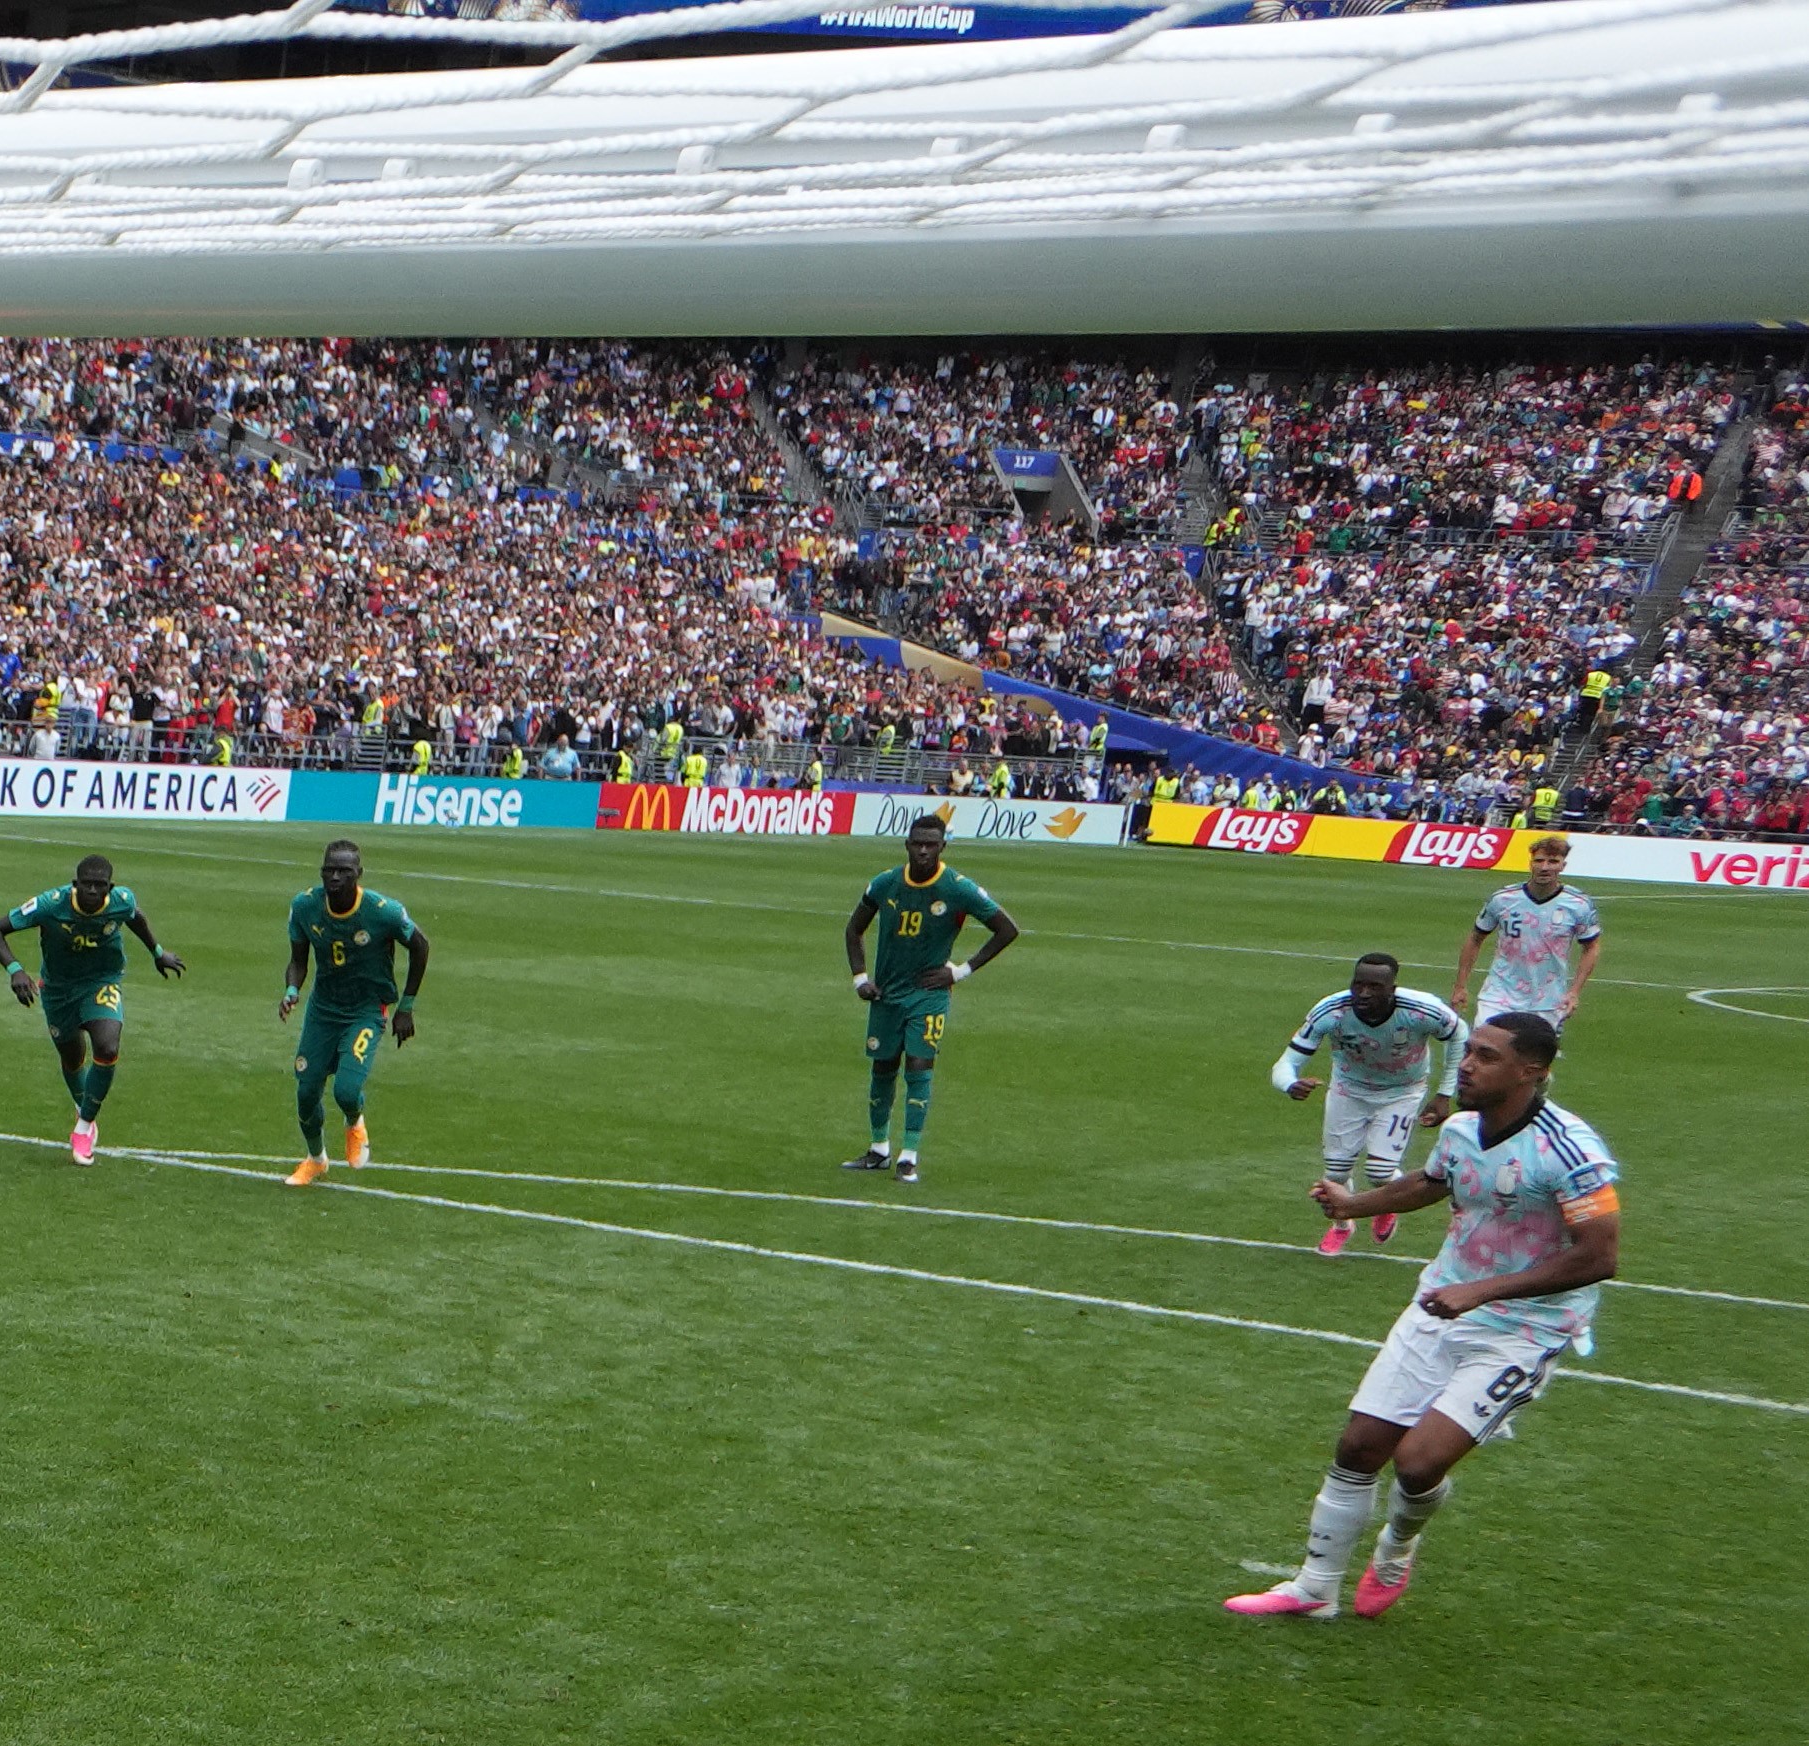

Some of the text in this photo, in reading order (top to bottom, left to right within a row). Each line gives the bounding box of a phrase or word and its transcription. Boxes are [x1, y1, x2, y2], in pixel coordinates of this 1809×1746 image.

[32, 767, 76, 809] OF
[82, 769, 240, 813] AMERICA
[374, 773, 523, 828] Hisense
[680, 787, 833, 836] McDonald's
[976, 799, 1036, 839] Dove
[1208, 808, 1299, 853] Lay's
[1400, 822, 1497, 867] Lay's
[898, 911, 922, 936] 19
[332, 941, 346, 966] 6
[353, 1027, 374, 1054] 6
[923, 1014, 946, 1041] 19
[1386, 1114, 1412, 1141] 14
[1487, 1365, 1526, 1402] 8
